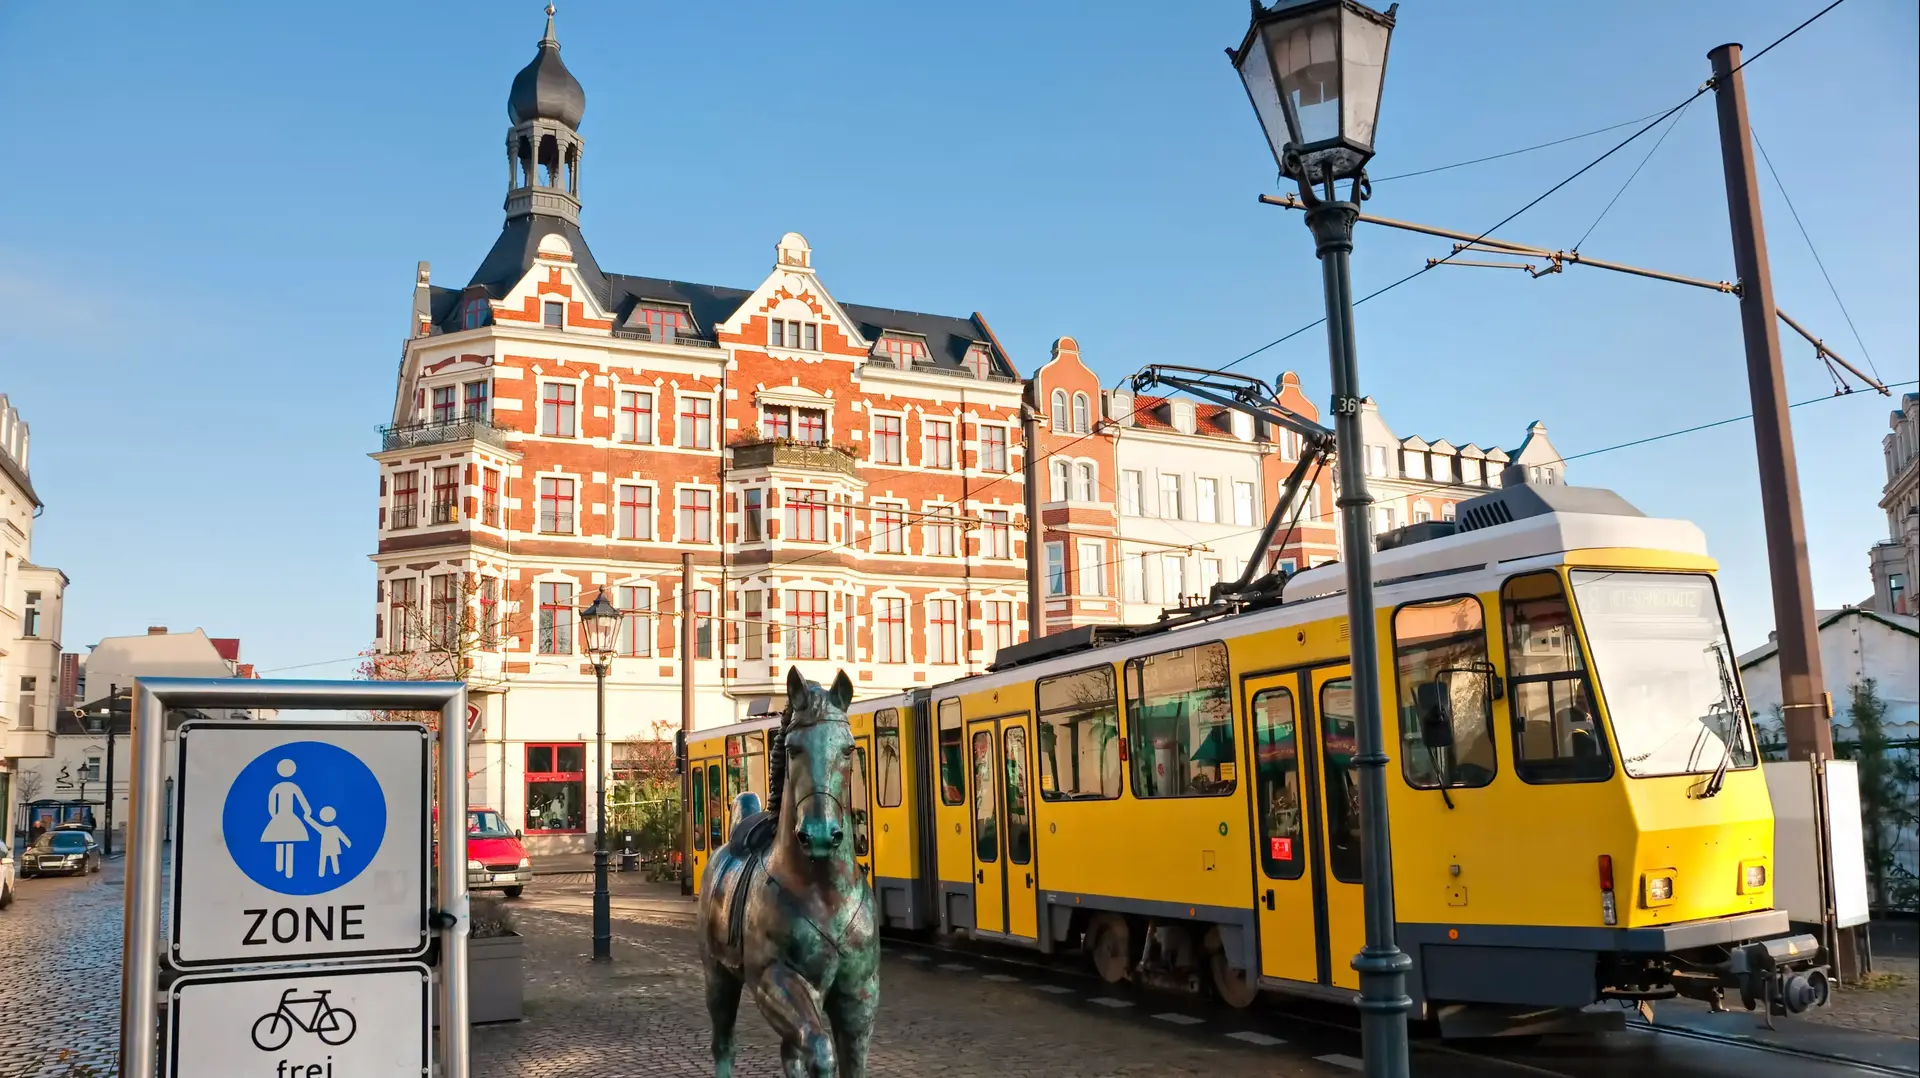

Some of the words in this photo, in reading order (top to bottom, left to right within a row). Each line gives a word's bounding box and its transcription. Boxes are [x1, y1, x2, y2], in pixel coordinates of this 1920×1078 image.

[1338, 397, 1357, 413] 36
[242, 904, 365, 945] ZONE
[277, 1055, 332, 1078] frei
